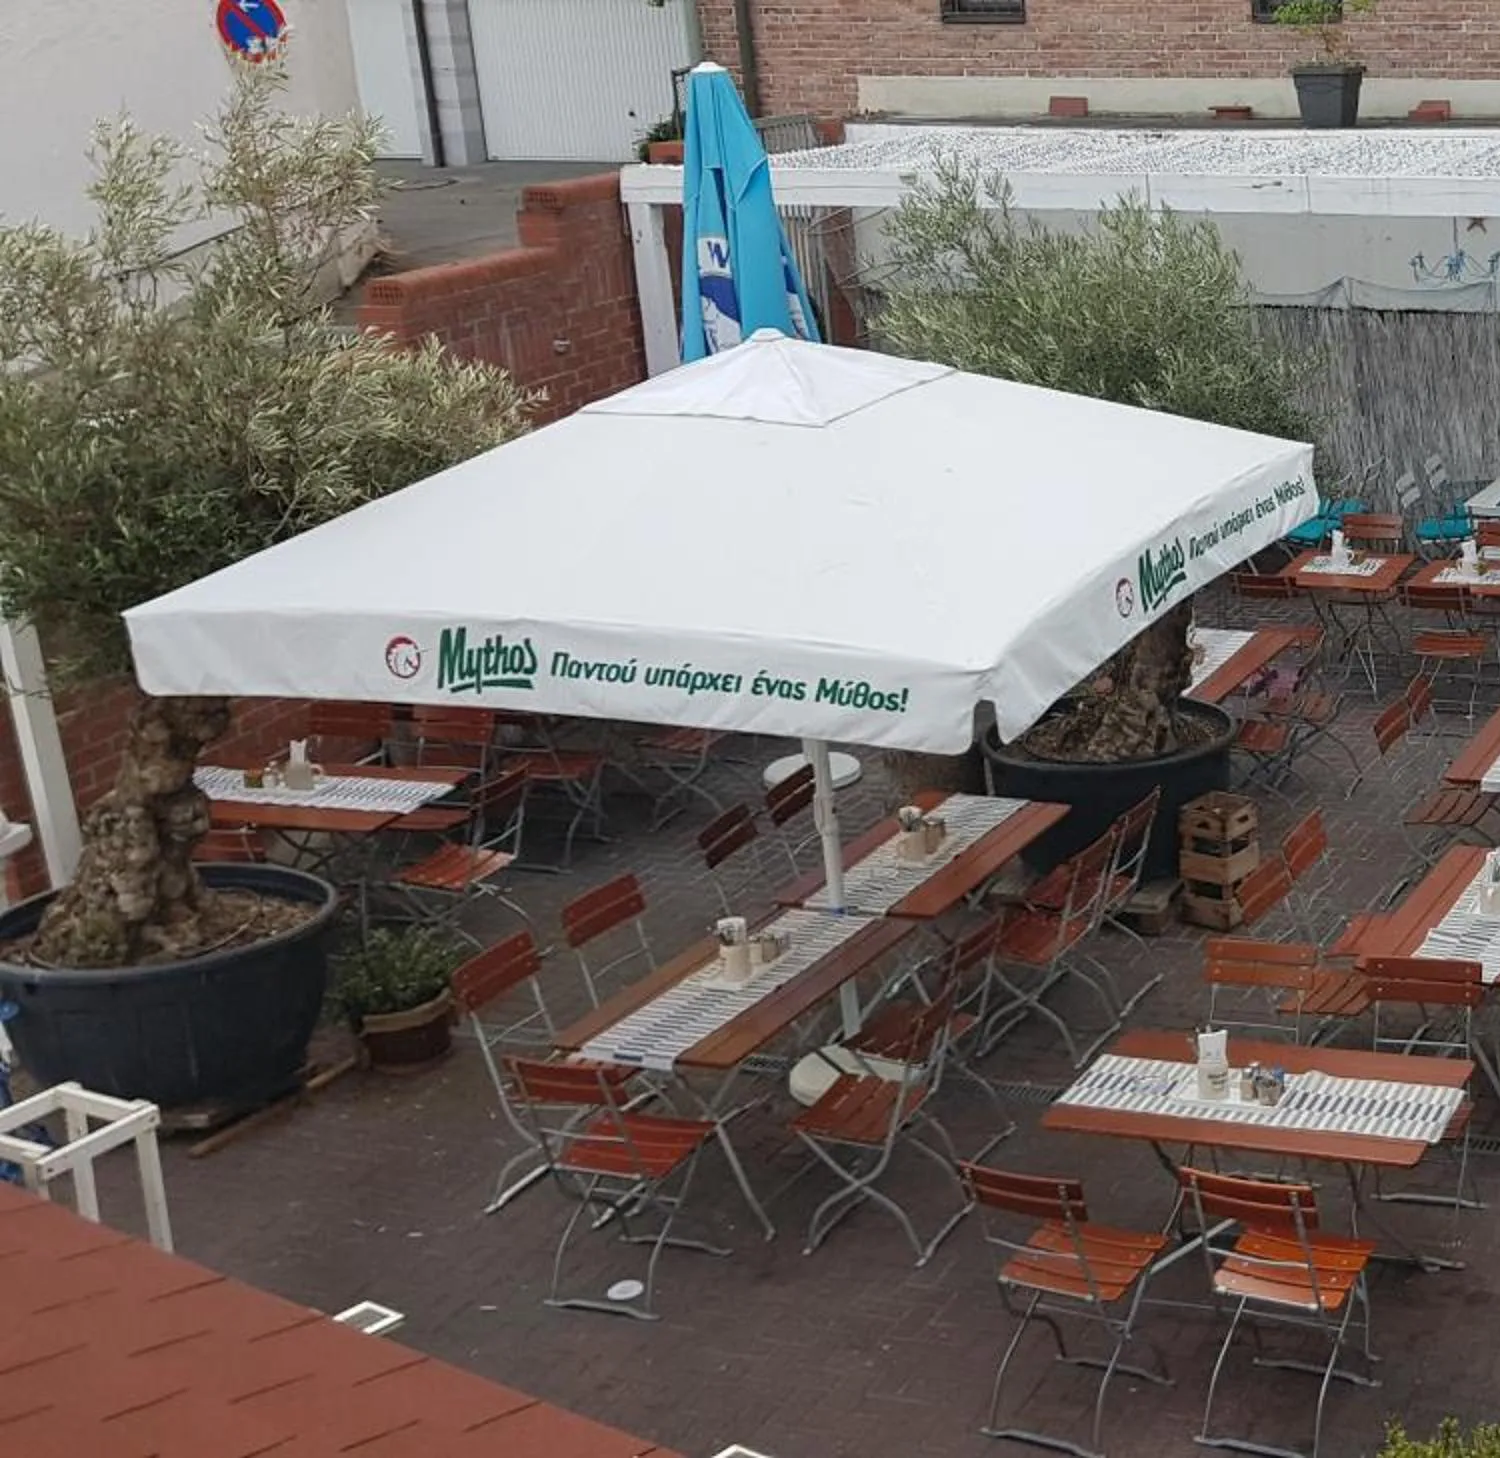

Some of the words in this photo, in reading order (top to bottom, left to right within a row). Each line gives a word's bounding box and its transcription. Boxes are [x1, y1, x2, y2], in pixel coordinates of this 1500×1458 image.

[1139, 536, 1187, 613] Mythos
[438, 626, 538, 694] Mythos
[551, 651, 637, 684] Παντού
[644, 663, 743, 695] υπάρχει
[751, 670, 807, 701] ένας
[815, 677, 909, 712] Μύθος!
